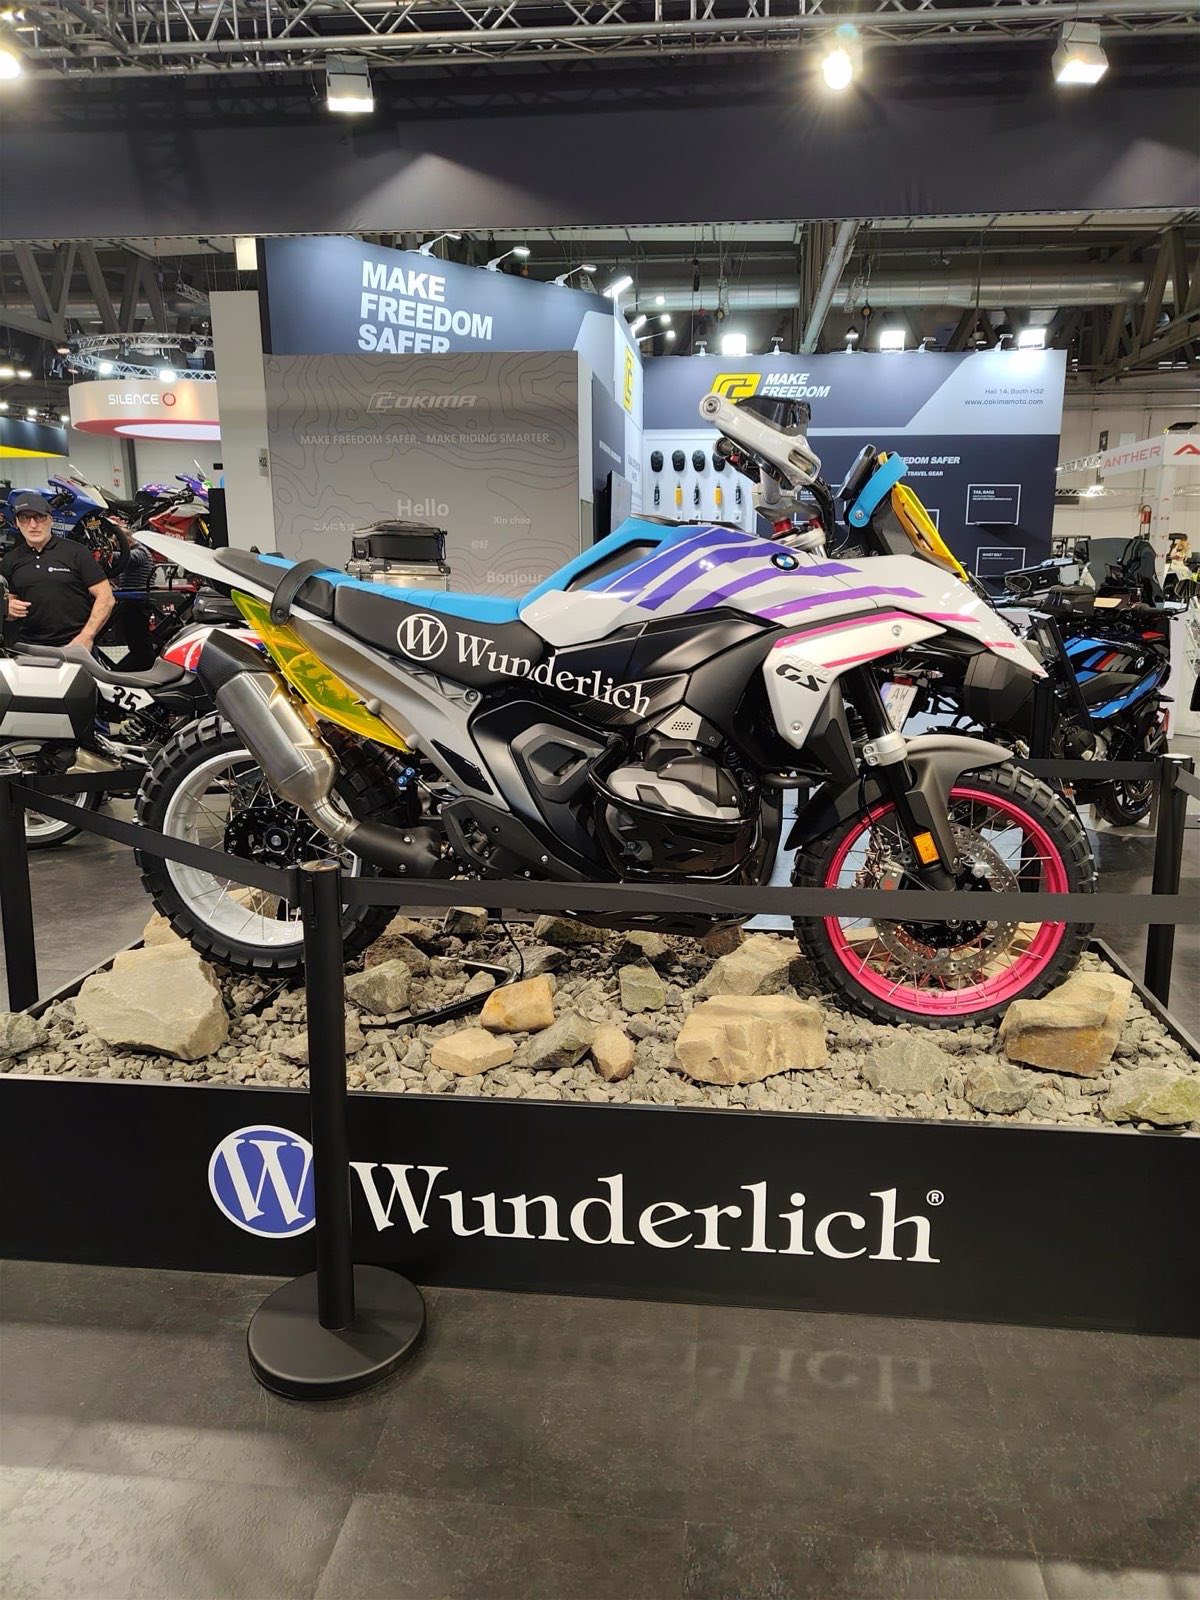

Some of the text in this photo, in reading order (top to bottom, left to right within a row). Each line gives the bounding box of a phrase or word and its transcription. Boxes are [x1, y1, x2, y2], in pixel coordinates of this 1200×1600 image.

[362, 260, 446, 303] MAKE
[360, 292, 493, 340] FREEDOM
[765, 373, 810, 385] MAKE
[108, 394, 159, 405] SILENCE
[760, 385, 831, 398] FREEDOM
[300, 435, 330, 445] MAKE
[333, 435, 383, 444] FREEDOM
[426, 434, 457, 444] MAKE
[459, 434, 497, 443] RIDING
[499, 433, 550, 443] SMARTER
[930, 456, 961, 465] SAFER
[1103, 445, 1162, 469] ANTHER
[397, 499, 450, 518] Hello
[455, 631, 651, 718] Wunderlich
